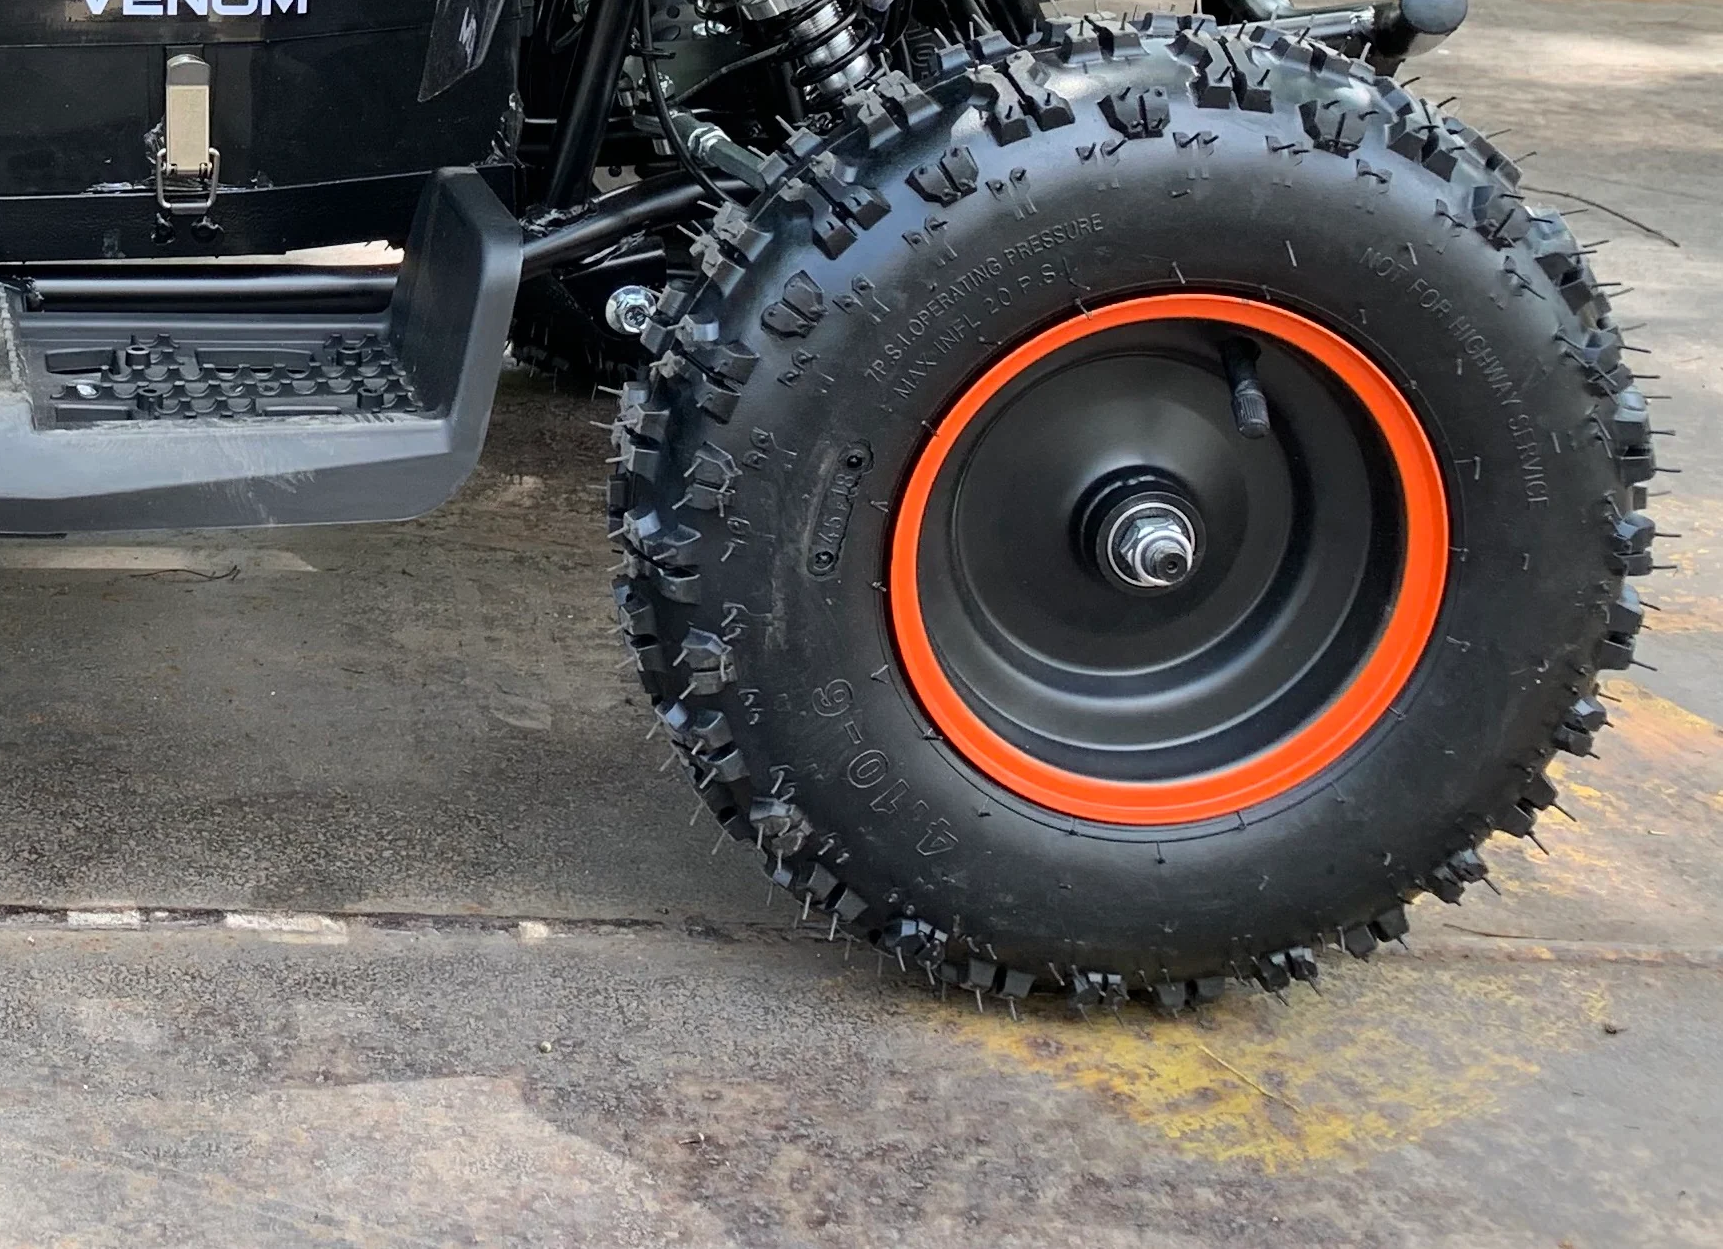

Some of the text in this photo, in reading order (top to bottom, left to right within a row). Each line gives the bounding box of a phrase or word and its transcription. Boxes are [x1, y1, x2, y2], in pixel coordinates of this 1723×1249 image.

[1004, 213, 1105, 266] PRESSURE
[893, 352, 937, 400] MAX
[933, 313, 981, 355] INFL
[983, 287, 1013, 315] 20
[1358, 247, 1550, 511] NOT FOR HIGHWAY SERVICE
